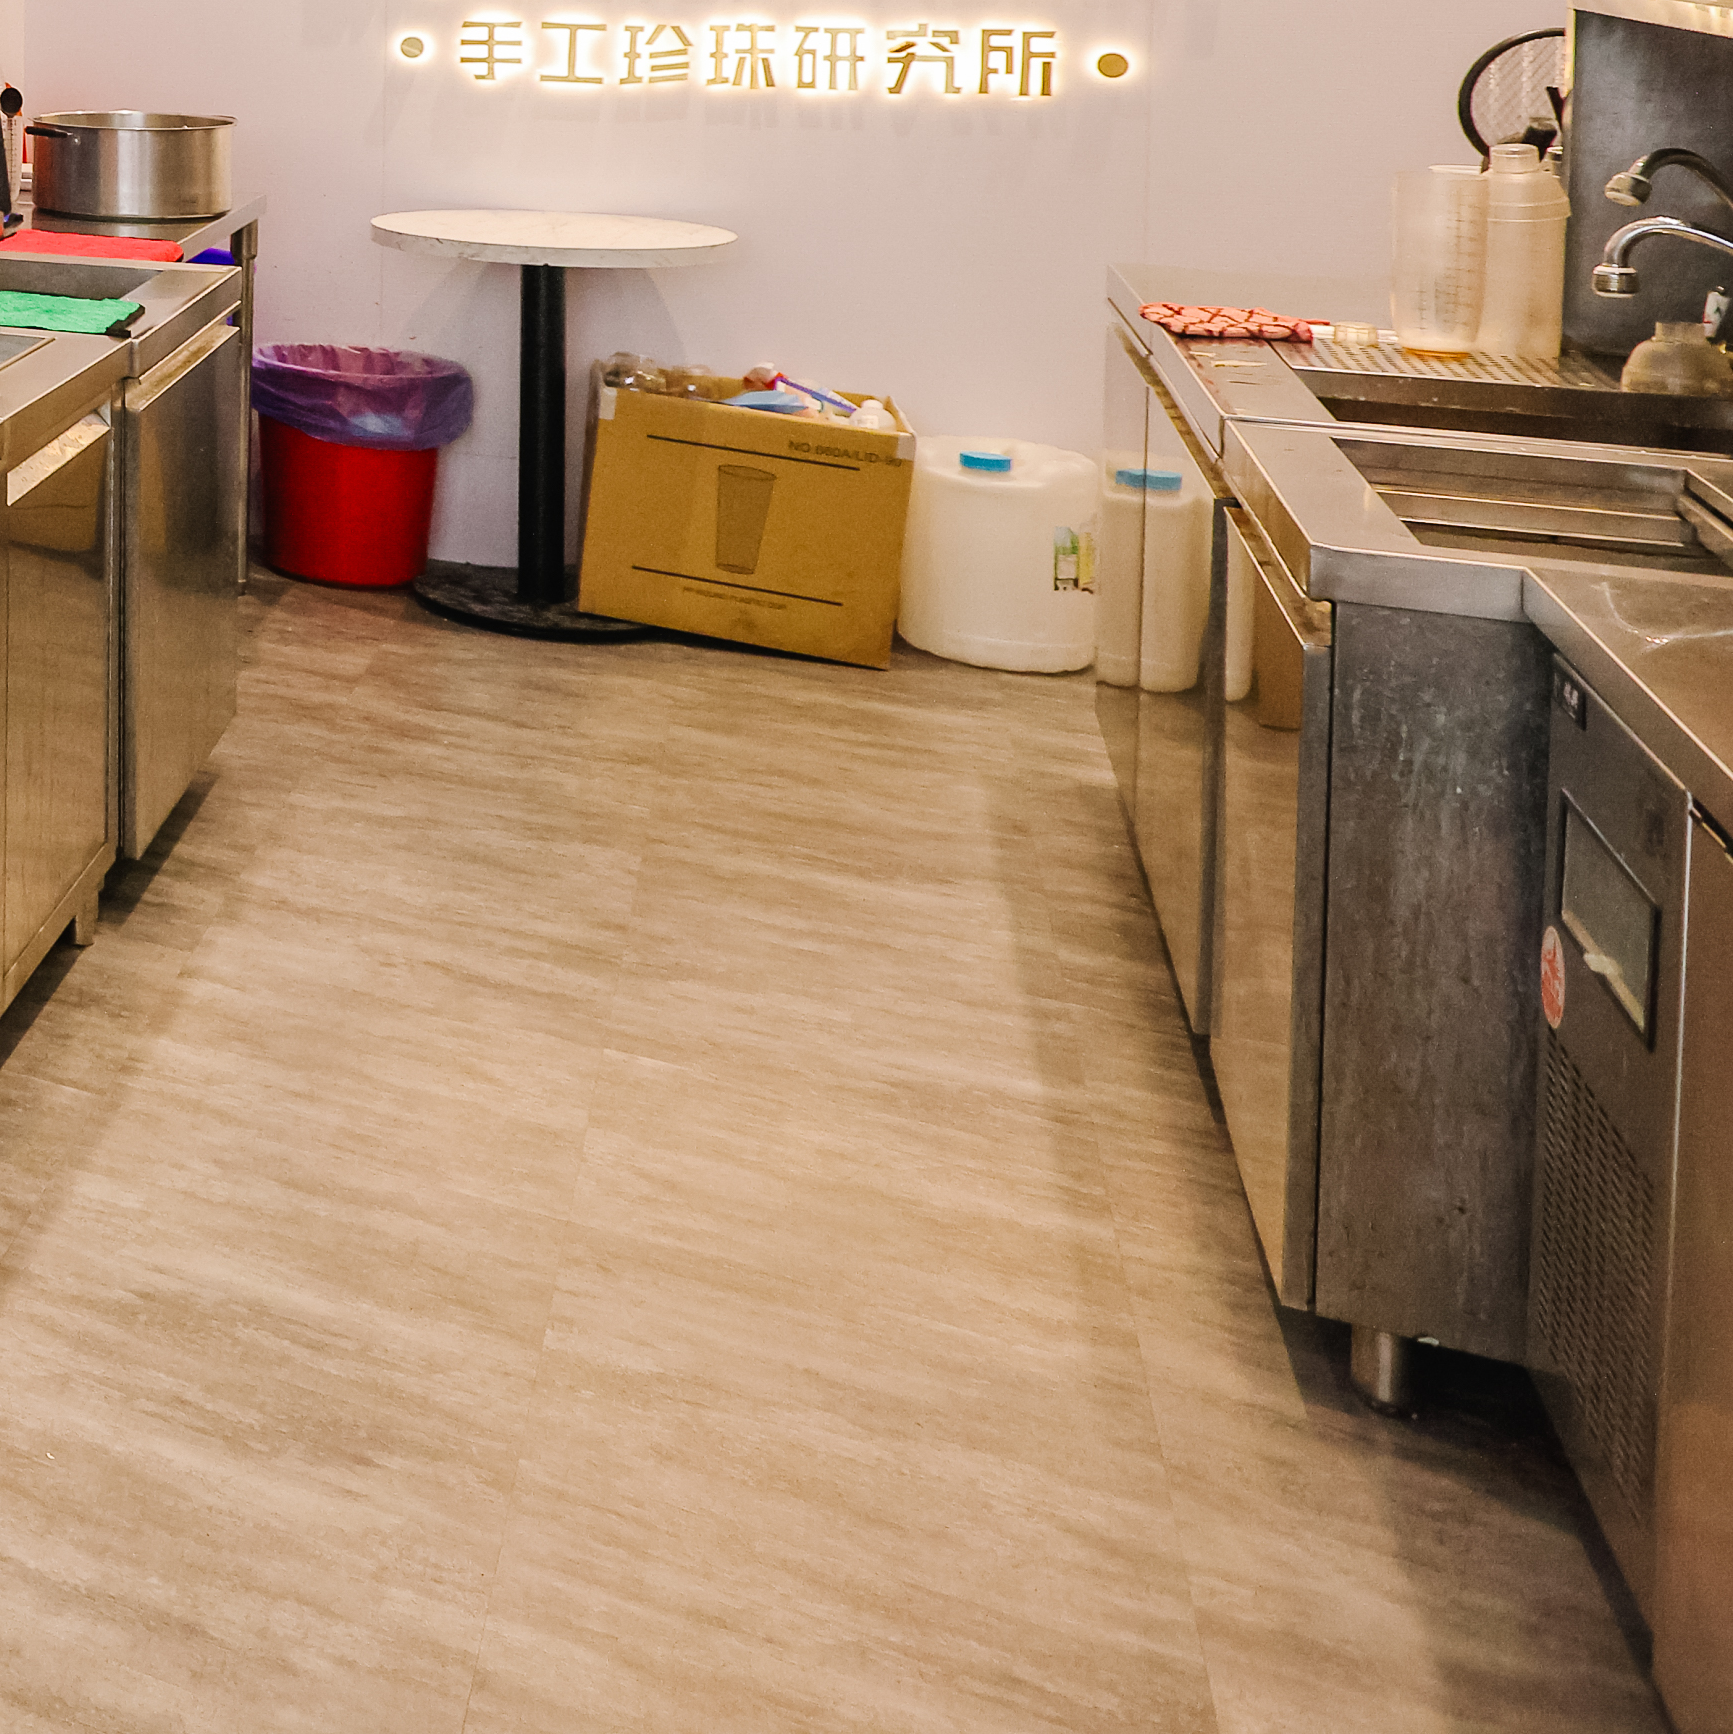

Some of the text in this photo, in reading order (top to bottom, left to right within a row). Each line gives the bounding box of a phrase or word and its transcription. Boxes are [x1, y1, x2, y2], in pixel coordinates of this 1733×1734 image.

[459, 19, 1058, 98] 手工珍珠研究所
